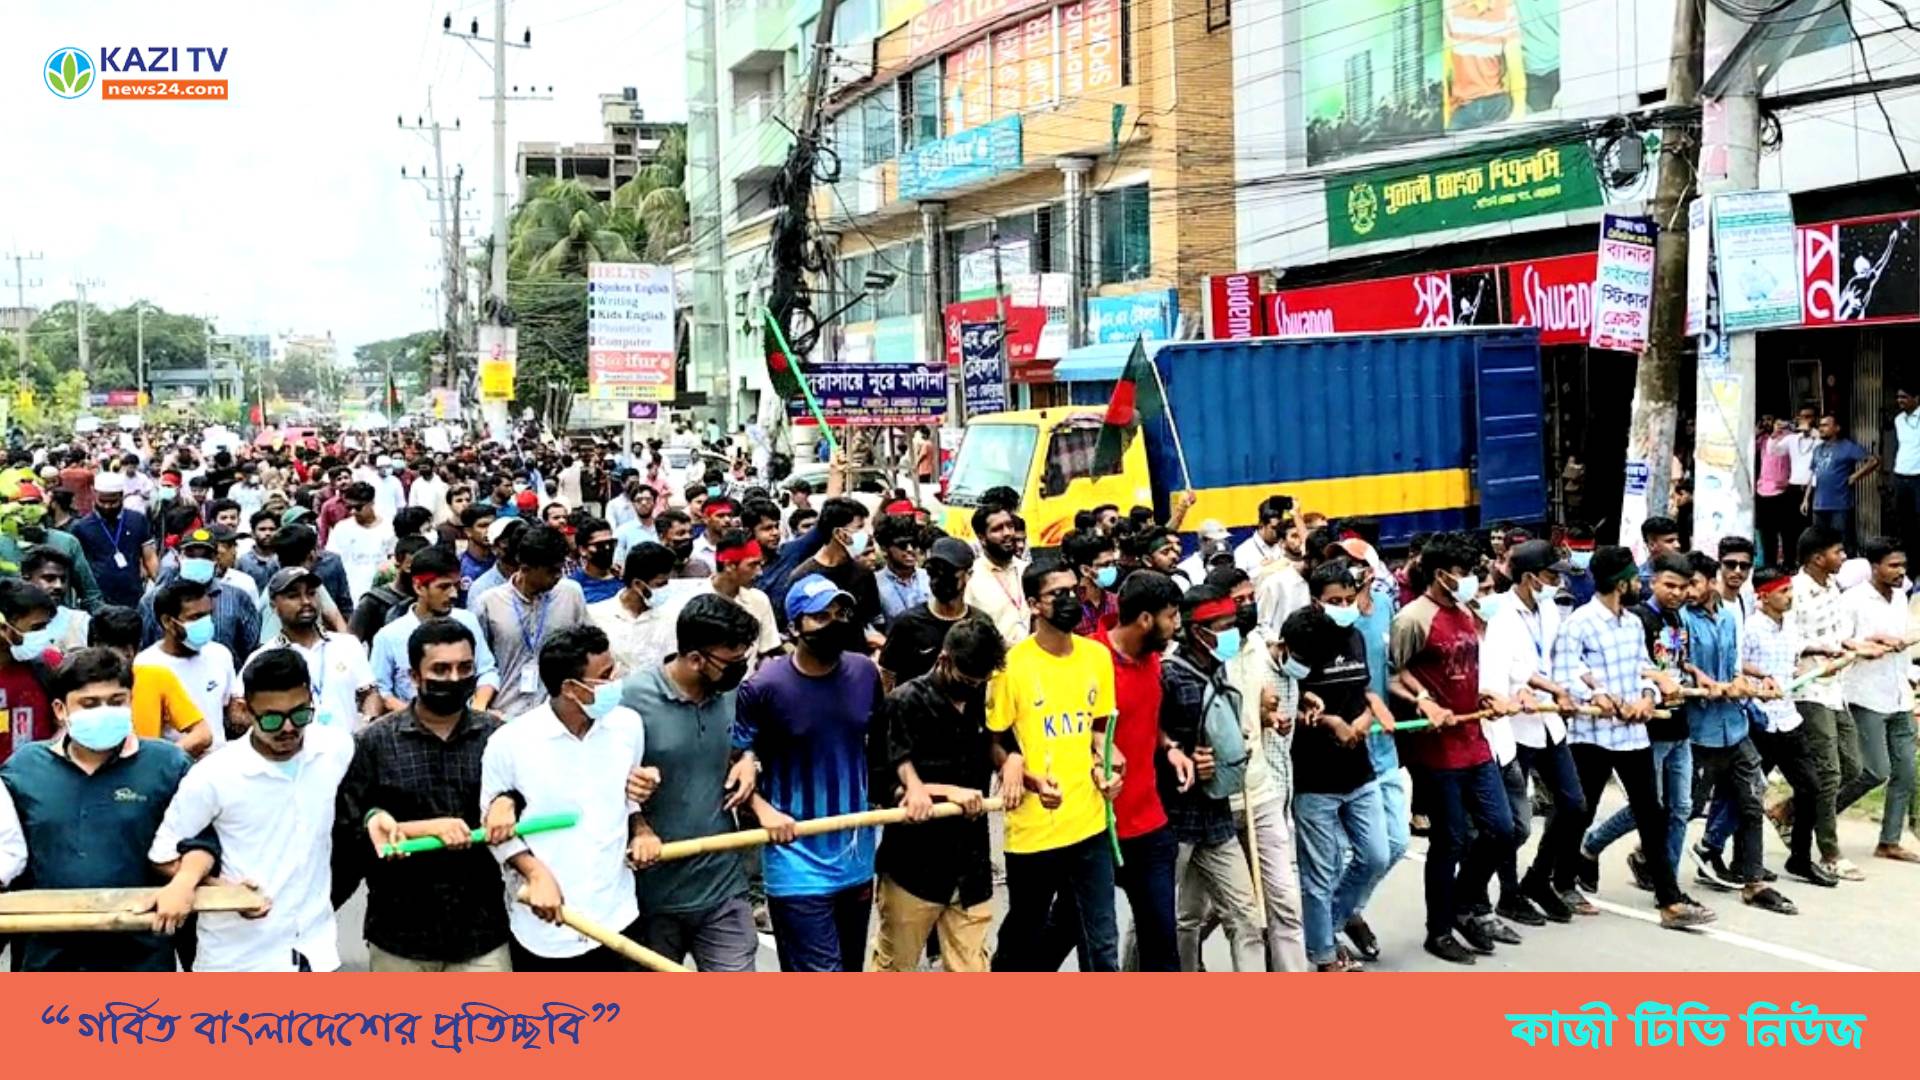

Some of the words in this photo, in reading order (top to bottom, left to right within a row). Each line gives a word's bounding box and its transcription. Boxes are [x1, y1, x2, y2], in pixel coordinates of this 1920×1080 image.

[597, 296, 639, 310] Writing
[597, 309, 622, 320] Kids
[625, 309, 668, 322] English
[598, 335, 653, 349] Computer
